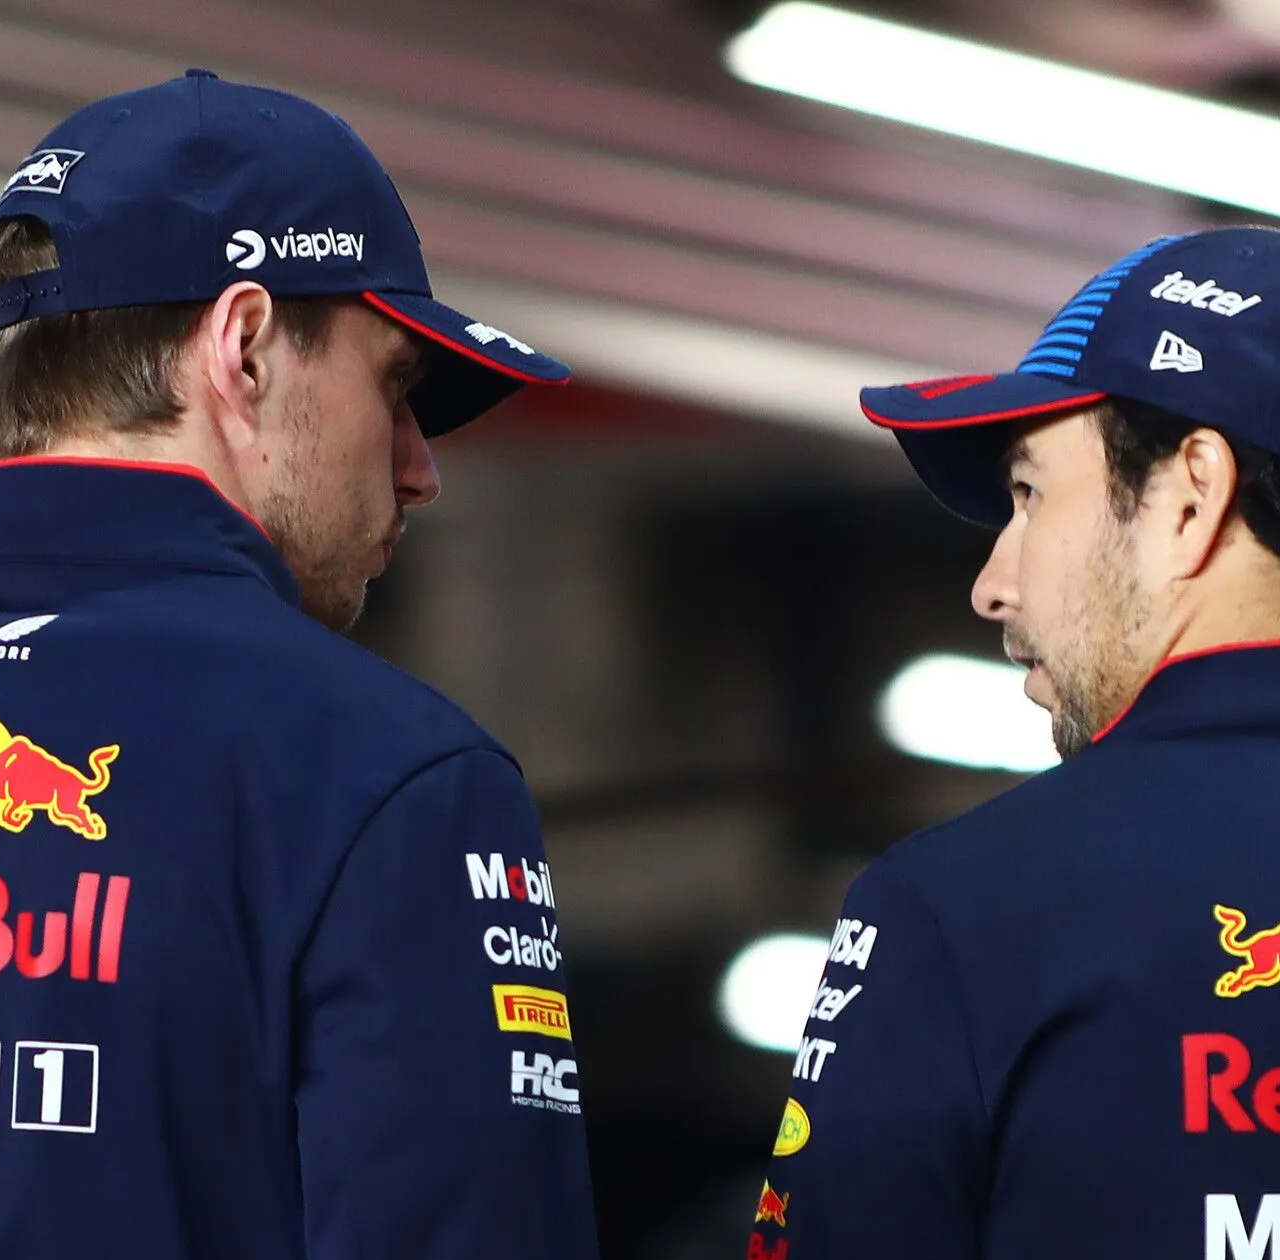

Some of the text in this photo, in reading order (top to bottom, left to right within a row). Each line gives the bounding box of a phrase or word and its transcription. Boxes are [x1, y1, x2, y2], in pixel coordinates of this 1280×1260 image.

[271, 227, 364, 262] viaplay
[1150, 270, 1262, 317] telcel
[465, 852, 556, 909] Mobil
[503, 995, 568, 1029] PIRELLI
[511, 1050, 579, 1103] HRC
